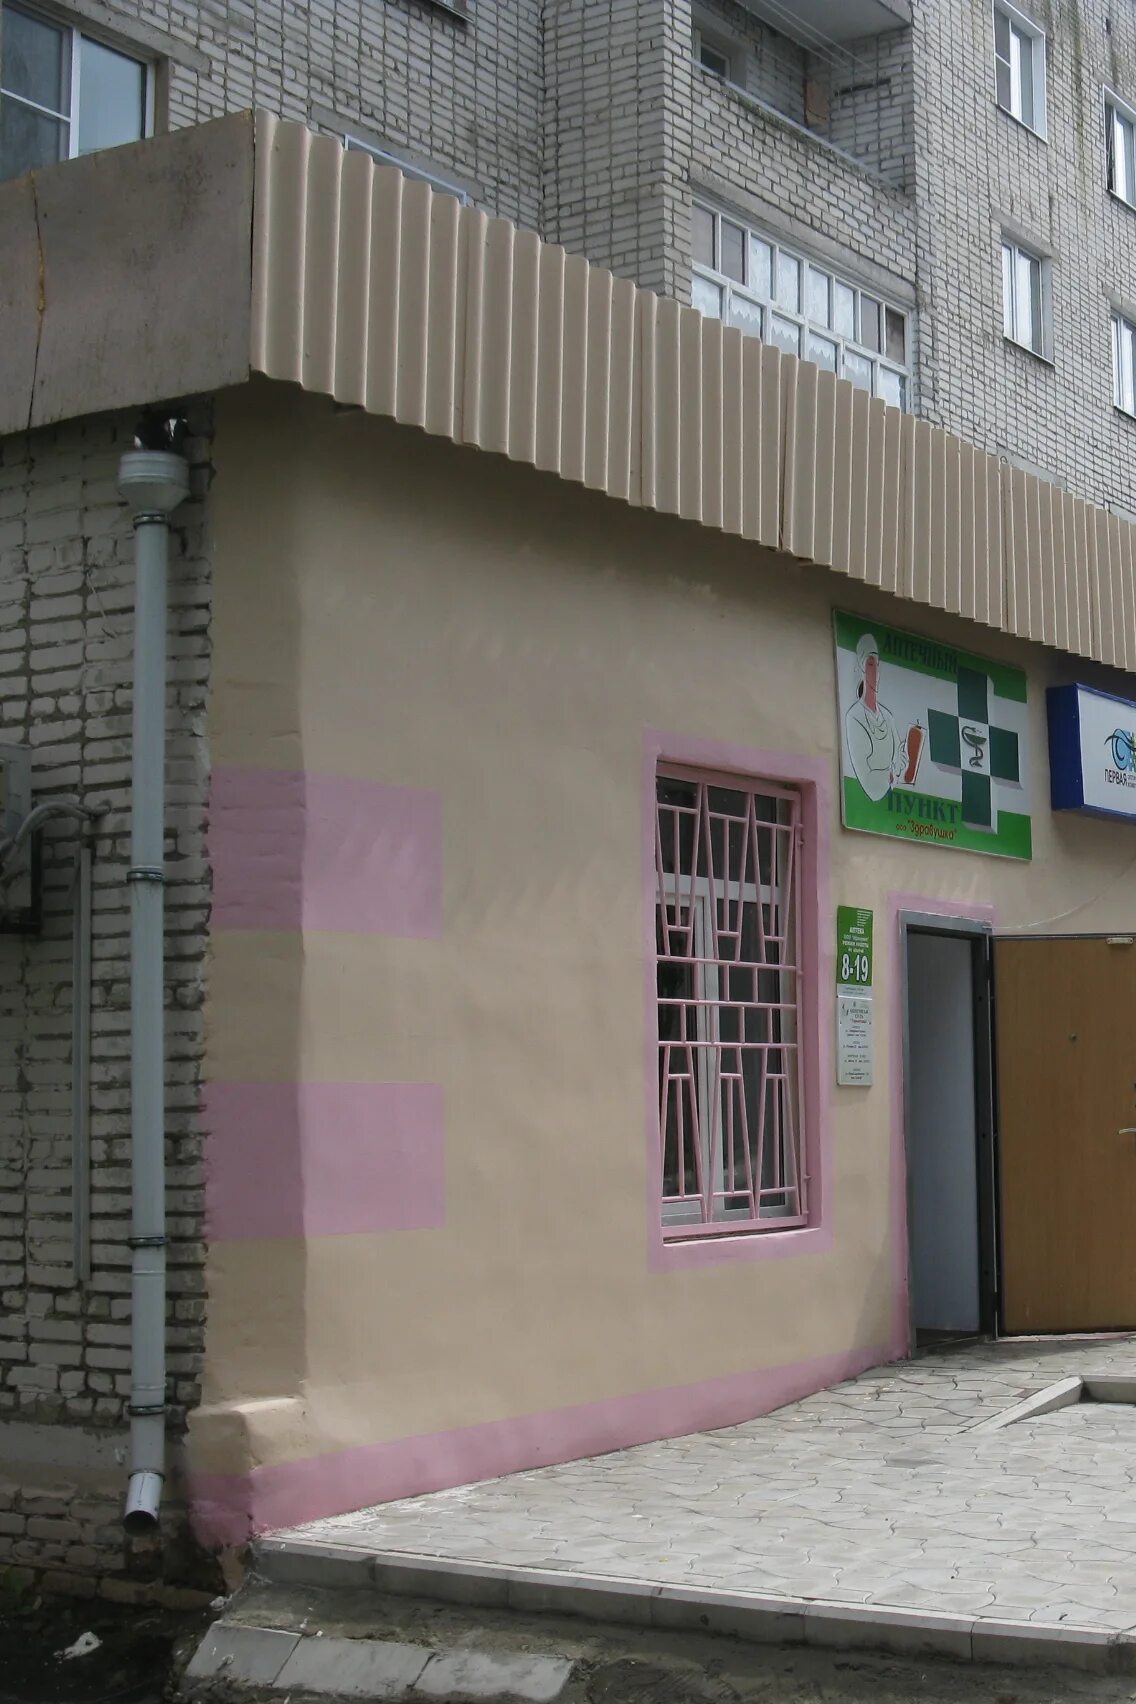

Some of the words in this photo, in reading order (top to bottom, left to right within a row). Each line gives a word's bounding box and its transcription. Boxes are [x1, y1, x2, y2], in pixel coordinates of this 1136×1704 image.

[885, 633, 959, 676] АПТЕЧНЫЙ
[1104, 769, 1127, 786] ПЕРВАЯ
[887, 790, 958, 823] ПУНКТ
[841, 953, 869, 982] 8-19
